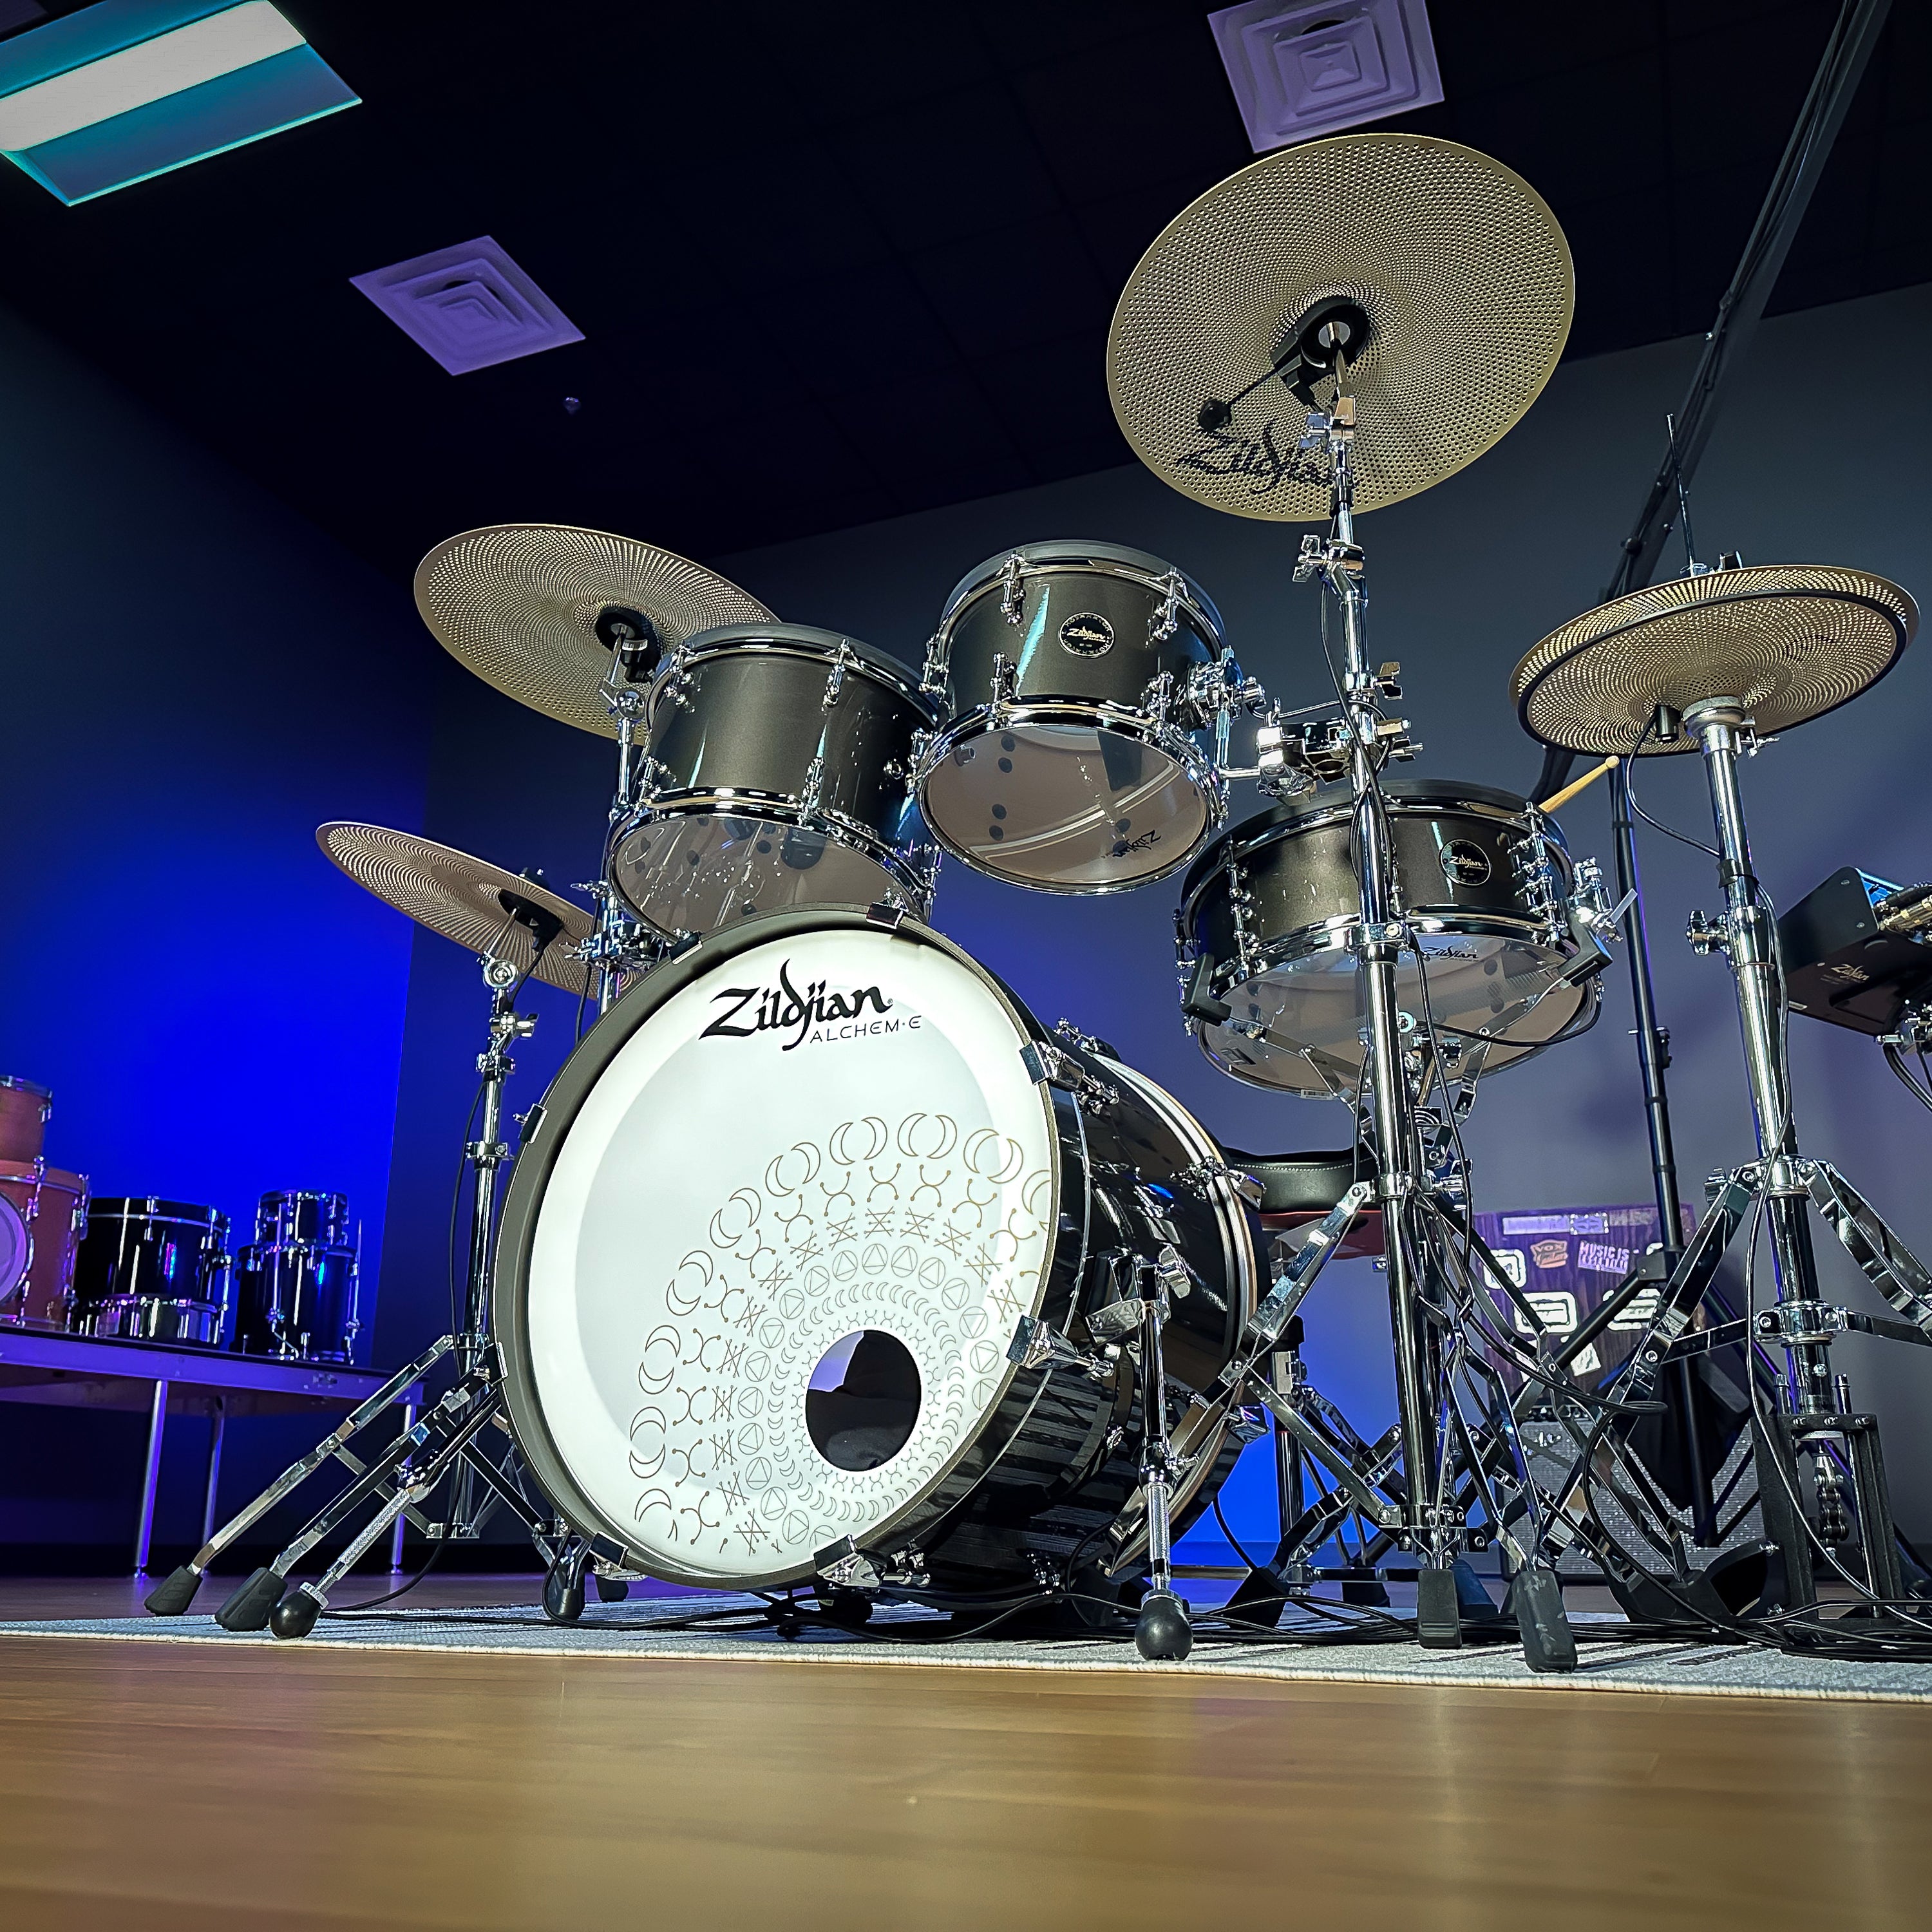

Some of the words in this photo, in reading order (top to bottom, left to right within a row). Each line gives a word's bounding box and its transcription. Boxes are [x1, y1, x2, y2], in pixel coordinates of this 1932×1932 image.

[1174, 418, 1360, 495] Zildjia
[1066, 625, 1106, 640] Zildjian
[1449, 854, 1482, 868] Zildjian
[698, 958, 893, 1051] Zildjian
[1579, 1240, 1616, 1260] MUSIC
